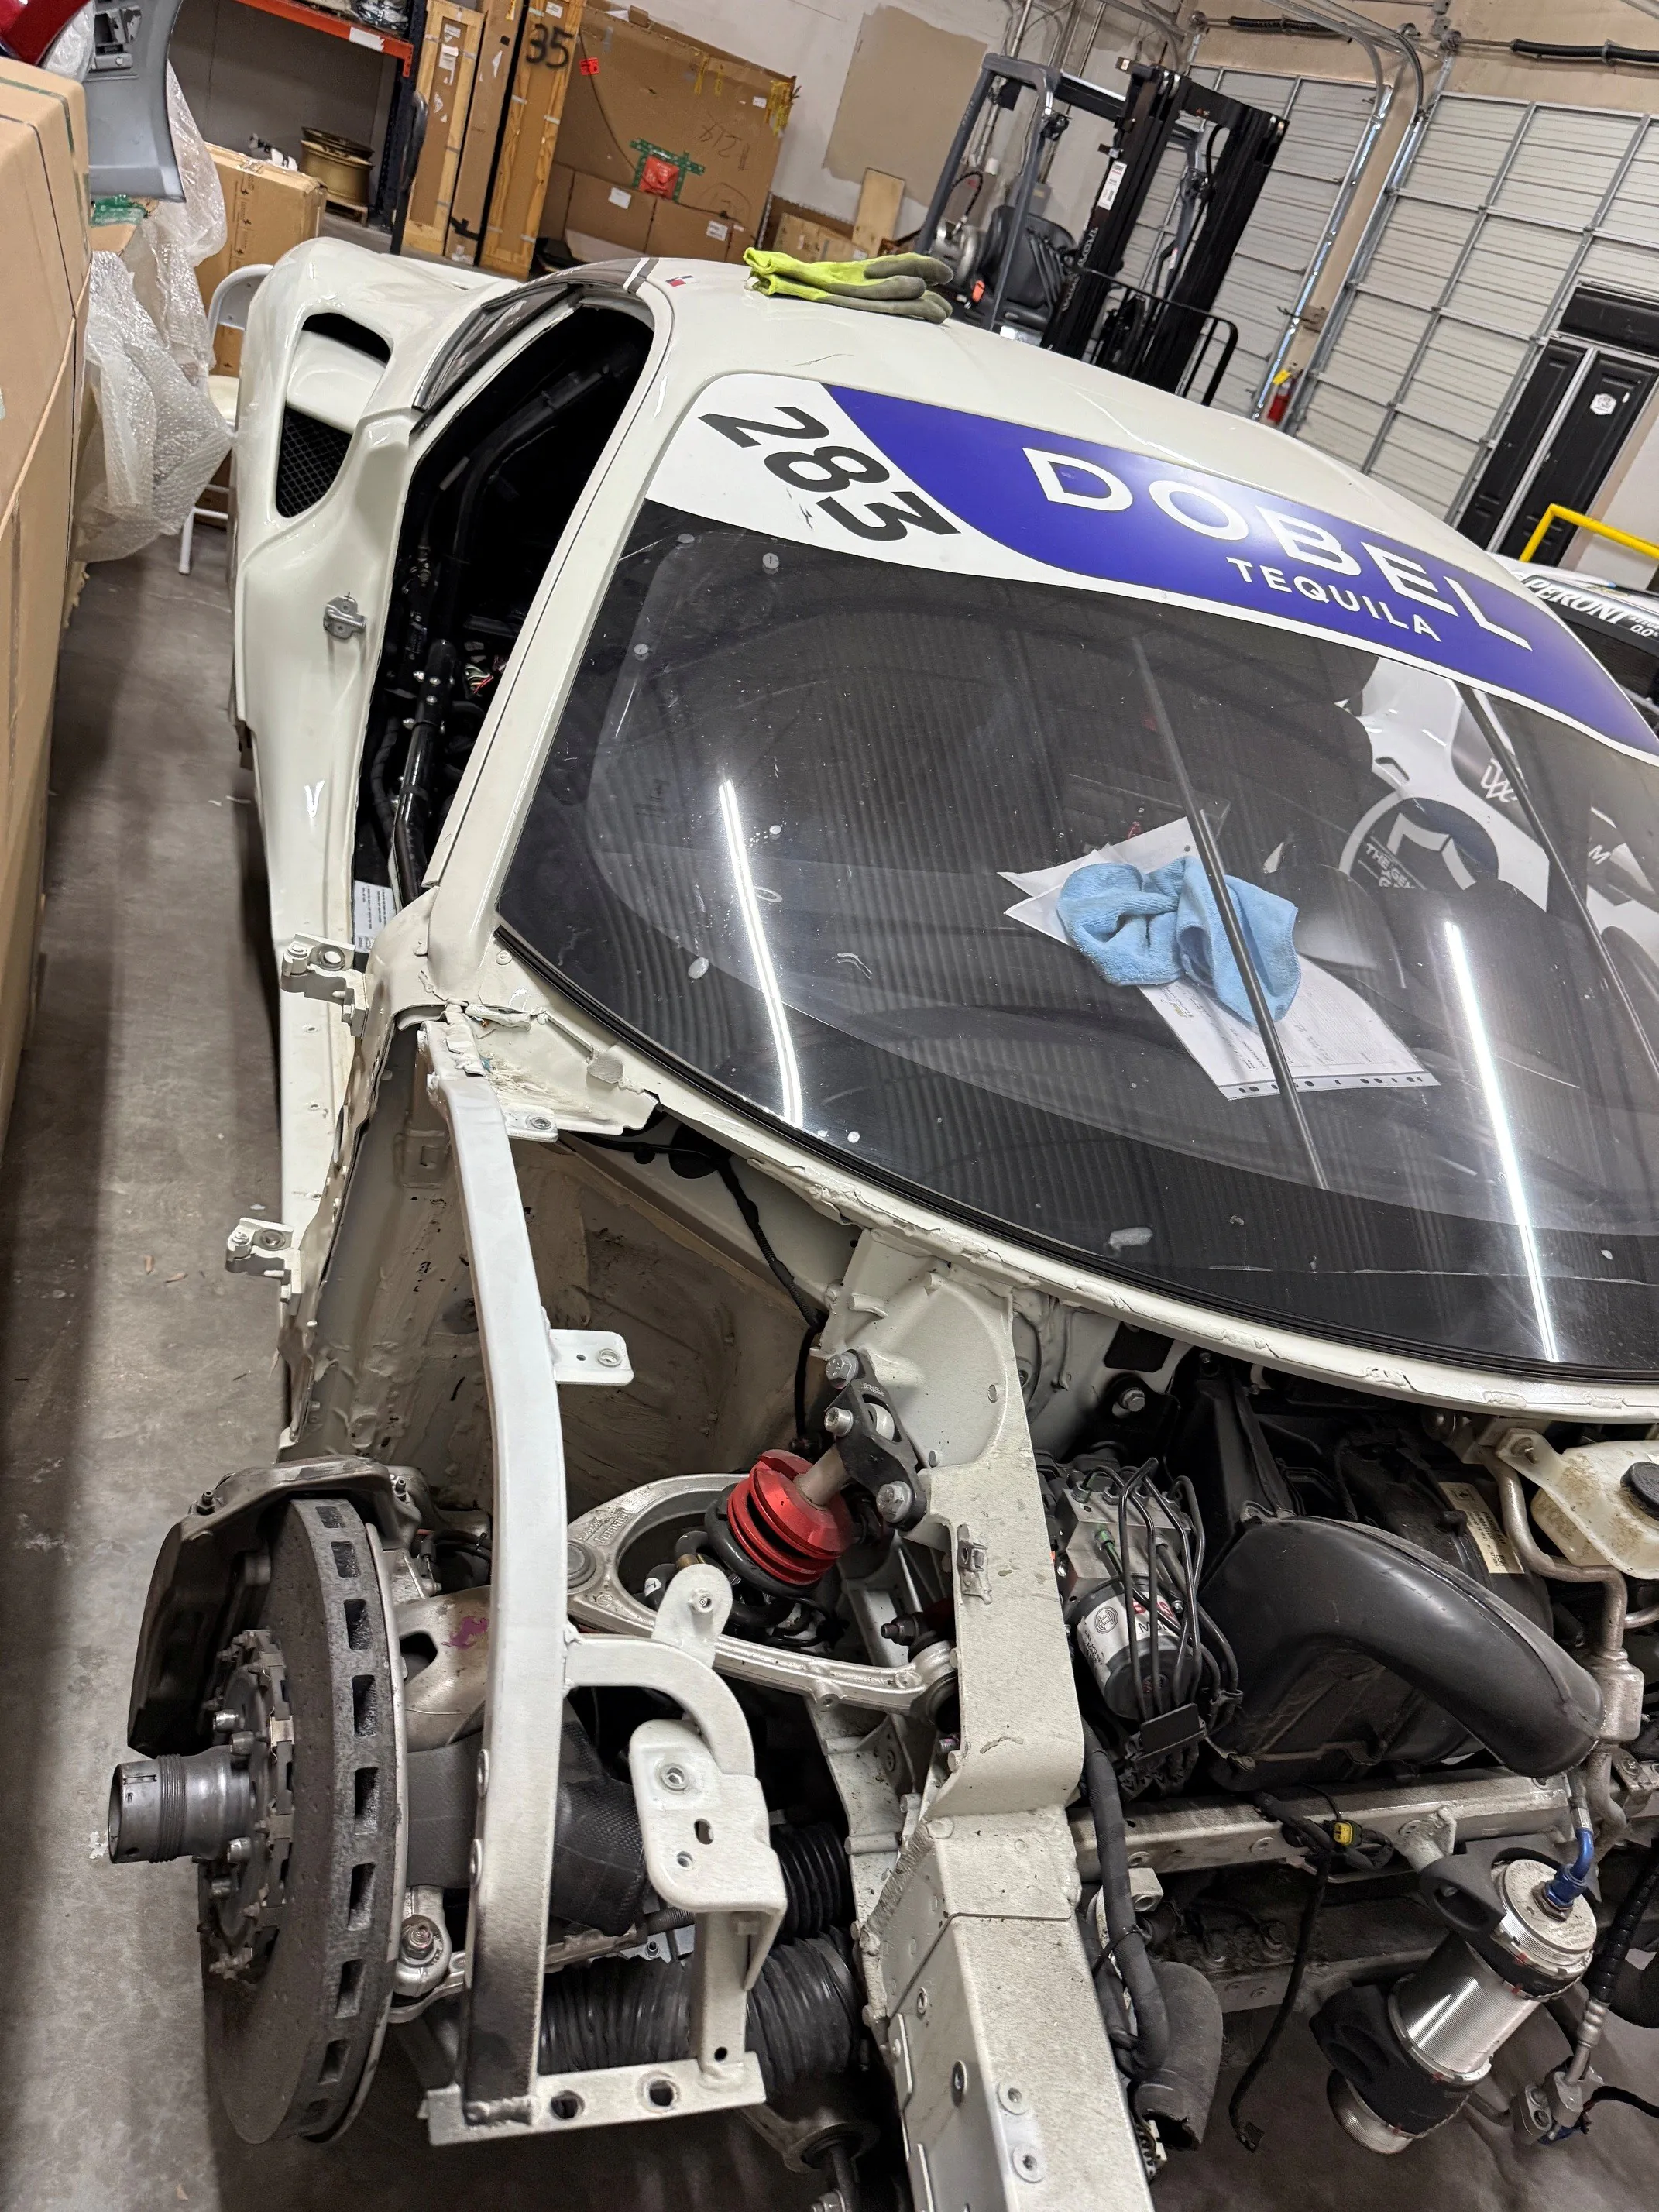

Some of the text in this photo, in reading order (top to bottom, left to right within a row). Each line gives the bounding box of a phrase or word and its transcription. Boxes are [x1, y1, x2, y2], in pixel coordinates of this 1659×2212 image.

[525, 22, 574, 70] 35
[697, 406, 962, 541] 283
[1022, 447, 1533, 651] DOBEL
[1226, 556, 1442, 643] TEQUILA
[1525, 577, 1626, 624] PERONI
